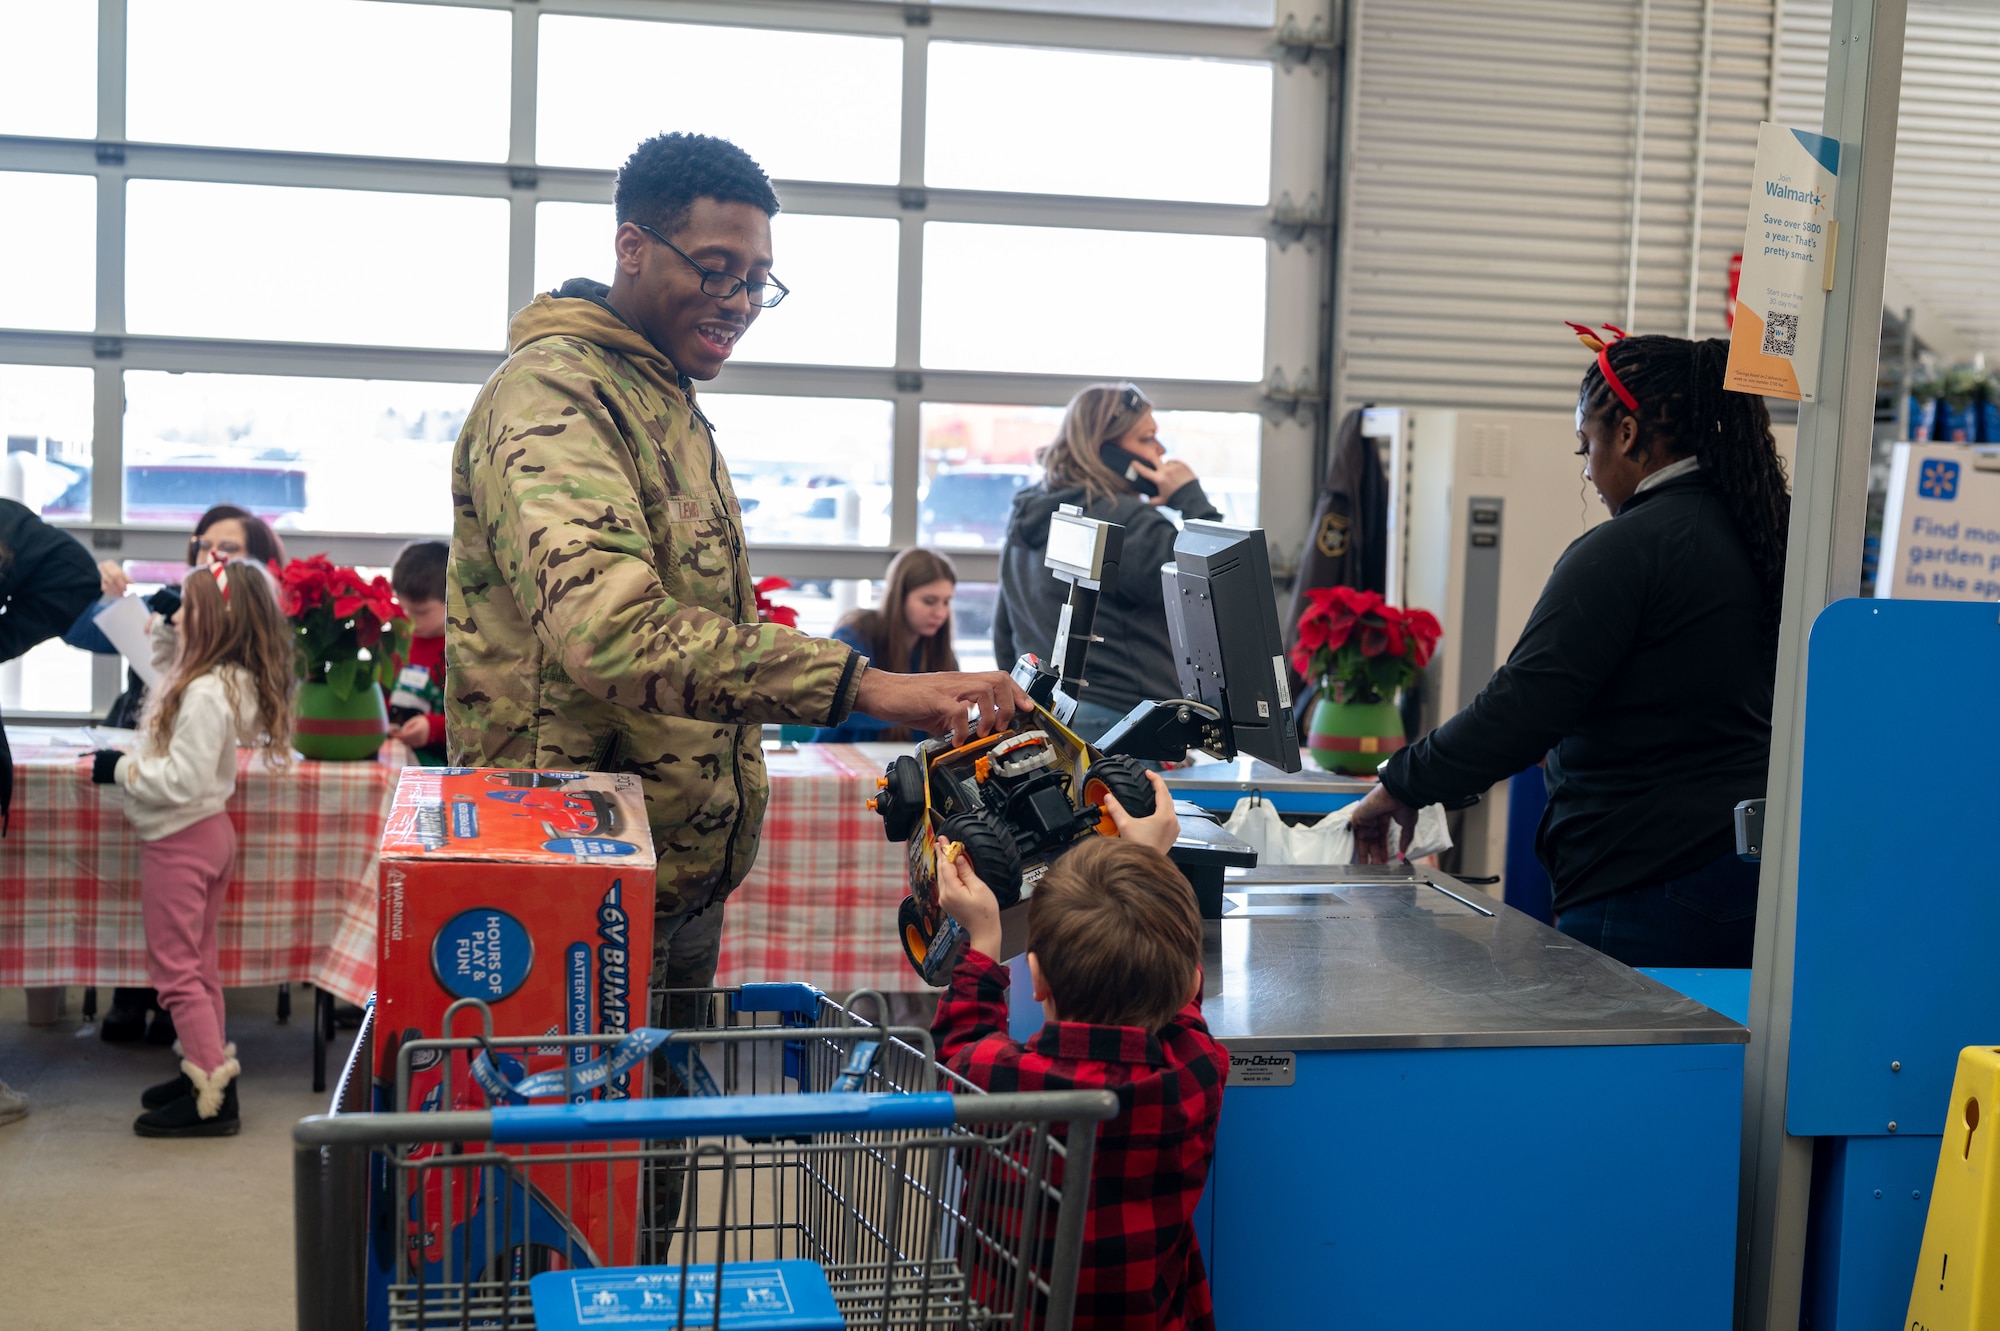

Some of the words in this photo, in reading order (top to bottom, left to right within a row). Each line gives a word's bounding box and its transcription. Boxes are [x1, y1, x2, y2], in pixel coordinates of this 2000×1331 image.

[1778, 173, 1792, 182] Join
[1764, 213, 1782, 226] Save
[1784, 220, 1801, 230] over
[1802, 221, 1822, 234] $800
[1765, 231, 1770, 239] a
[1795, 235, 1817, 248] That's
[1764, 246, 1790, 260] pretty
[1791, 252, 1814, 263] smart.
[1766, 287, 1780, 296] Start
[1780, 291, 1792, 299] your
[1793, 292, 1804, 301] free
[1912, 516, 1960, 540] Find
[1909, 545, 1985, 569] garden
[1905, 567, 1926, 588] in
[1933, 572, 1968, 592] the
[604, 906, 625, 944] 6V
[472, 930, 486, 967] PLAY
[486, 916, 502, 970] HOURS
[456, 938, 471, 975] FUN!
[472, 970, 486, 982] &
[488, 972, 502, 995] OF
[574, 952, 586, 1000] BATTERY
[575, 1004, 586, 1062] POWEED
[1229, 1055, 1290, 1066] Pan-Oston
